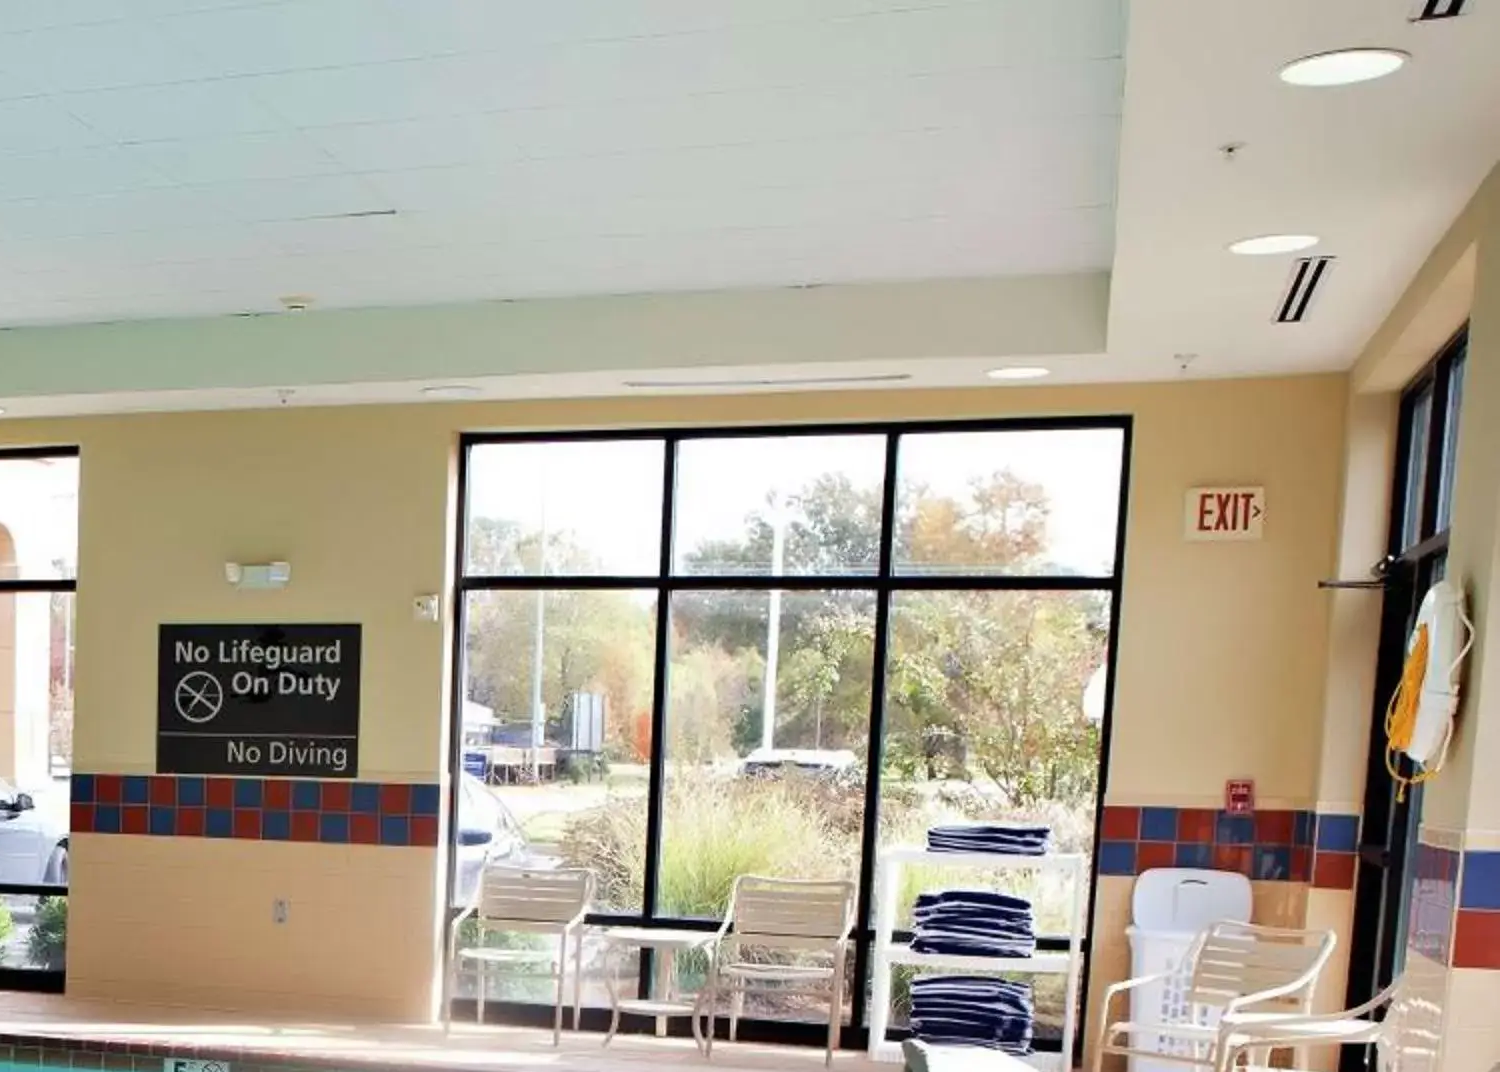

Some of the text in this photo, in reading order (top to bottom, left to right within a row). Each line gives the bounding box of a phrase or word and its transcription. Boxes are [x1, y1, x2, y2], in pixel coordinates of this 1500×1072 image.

[1197, 493, 1255, 531] EXIT
[174, 640, 342, 669] No Lifeguard
[232, 671, 341, 701] On Duty
[227, 741, 348, 771] No Diving
